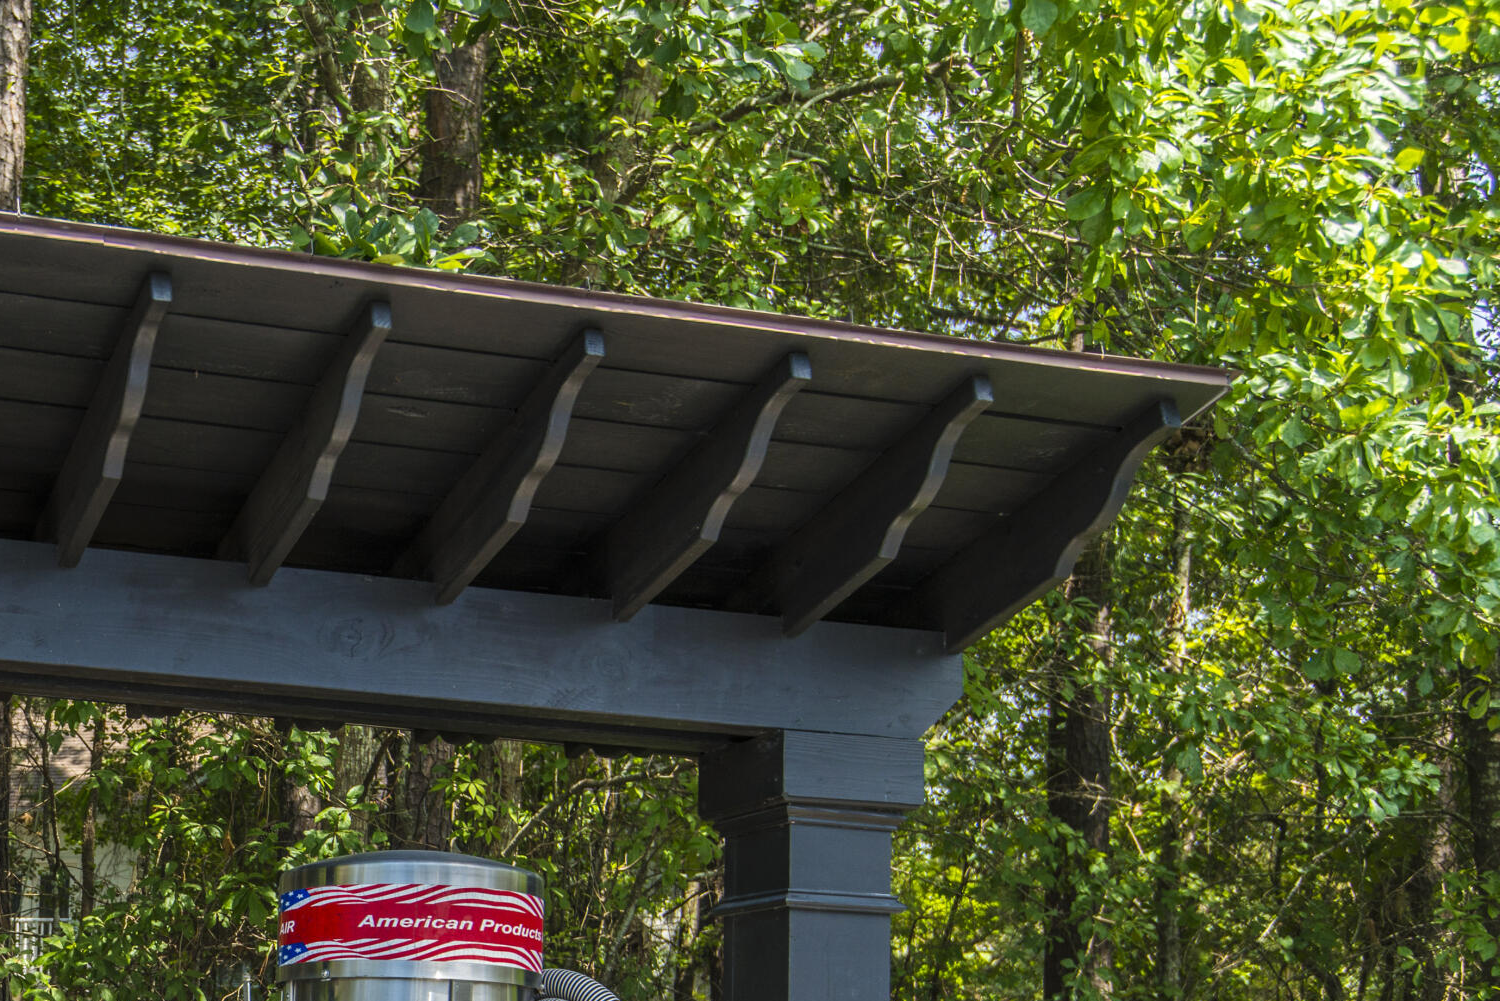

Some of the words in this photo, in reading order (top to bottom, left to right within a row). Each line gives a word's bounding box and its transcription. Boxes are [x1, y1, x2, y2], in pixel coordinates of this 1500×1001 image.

[279, 920, 296, 935] AIR
[358, 914, 473, 932] American
[479, 918, 542, 942] Products
